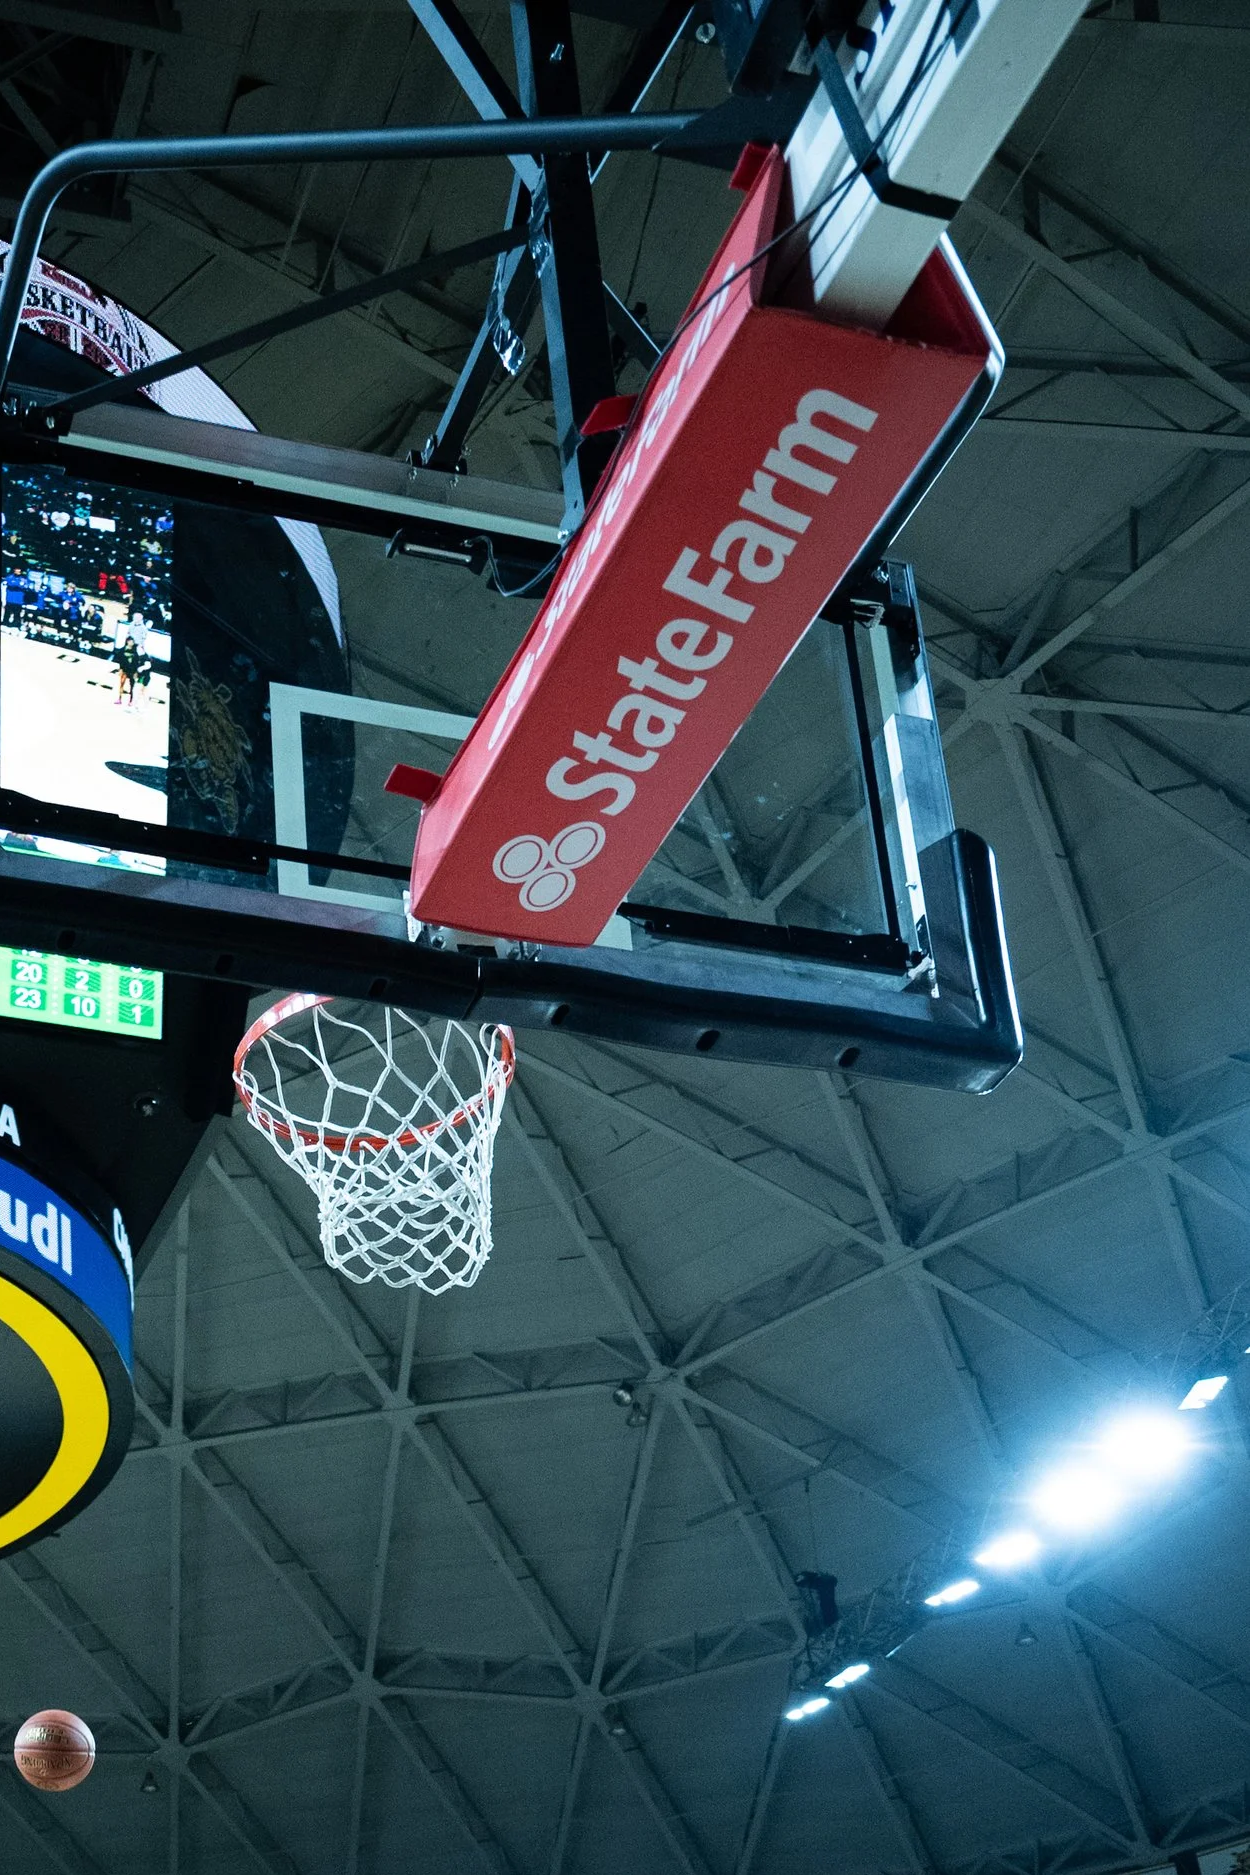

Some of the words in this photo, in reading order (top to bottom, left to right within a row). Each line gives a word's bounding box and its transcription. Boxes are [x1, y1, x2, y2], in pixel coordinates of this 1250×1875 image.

[15, 961, 42, 982] 20
[76, 970, 89, 991] 2
[129, 979, 143, 1000] 0
[15, 987, 42, 1009] 23
[72, 996, 96, 1017] 10
[132, 1004, 142, 1024] 1
